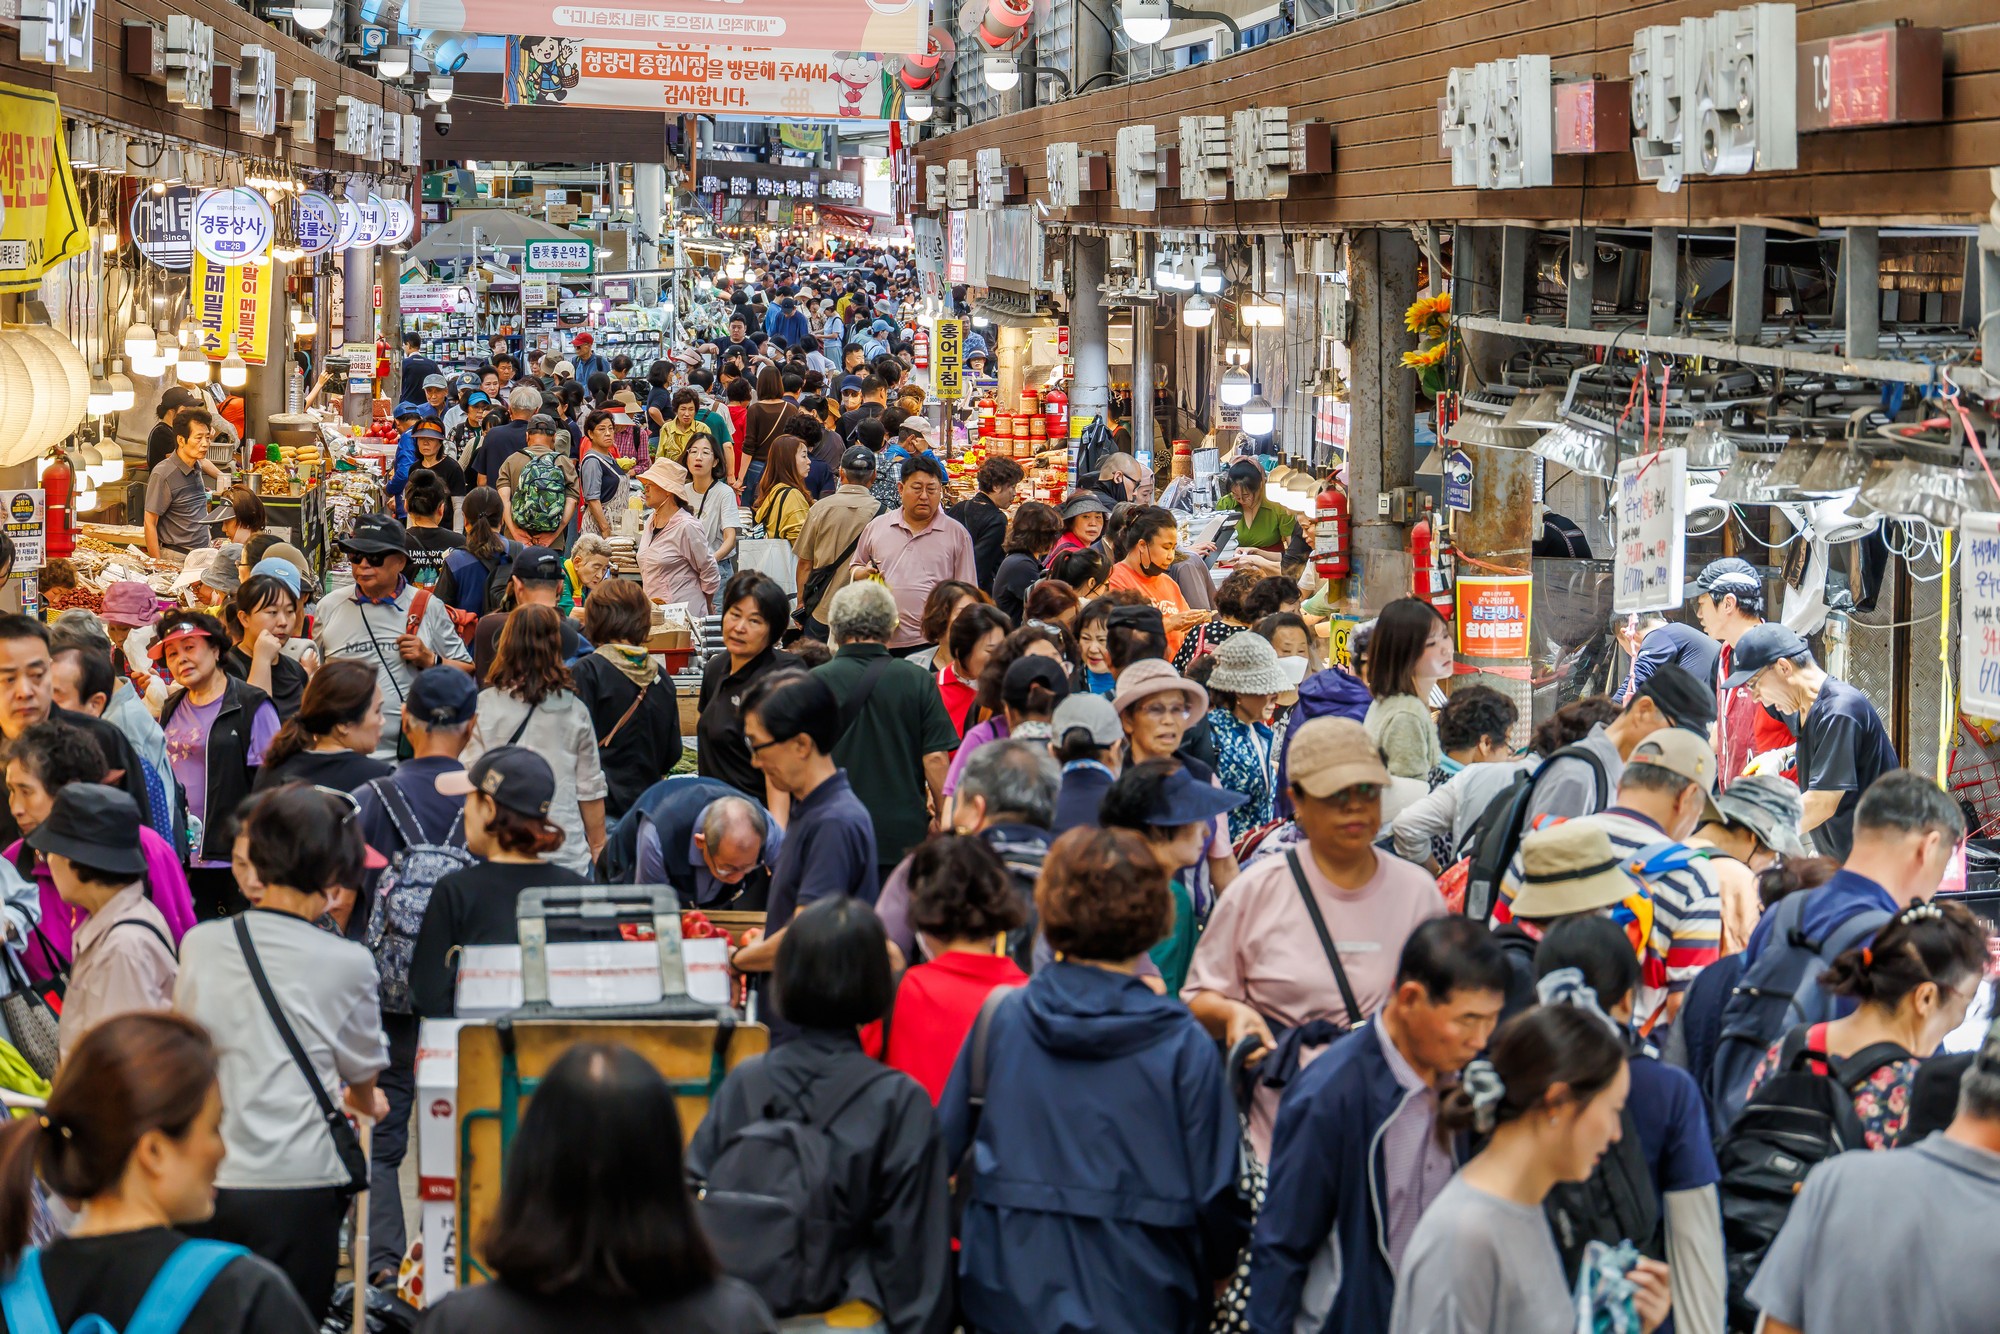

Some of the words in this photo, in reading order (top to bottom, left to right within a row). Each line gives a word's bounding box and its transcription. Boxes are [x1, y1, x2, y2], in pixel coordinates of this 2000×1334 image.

[585, 50, 635, 74] 청량리
[638, 53, 724, 80] 종합시장을
[727, 59, 776, 81] 방문해
[779, 62, 828, 82] 주셔서
[663, 85, 749, 107] 감사합니다.
[200, 215, 263, 236] 경동상사
[162, 234, 188, 242] Since
[219, 241, 241, 250] 나-28
[531, 245, 587, 259] 몸愛좋은약초
[237, 298, 257, 354] 메밀국수
[940, 323, 960, 387] 홍어무침
[1975, 570, 2000, 599] 온누
[1472, 605, 1520, 620] 환급행사
[1466, 622, 1523, 638] 참여점포
